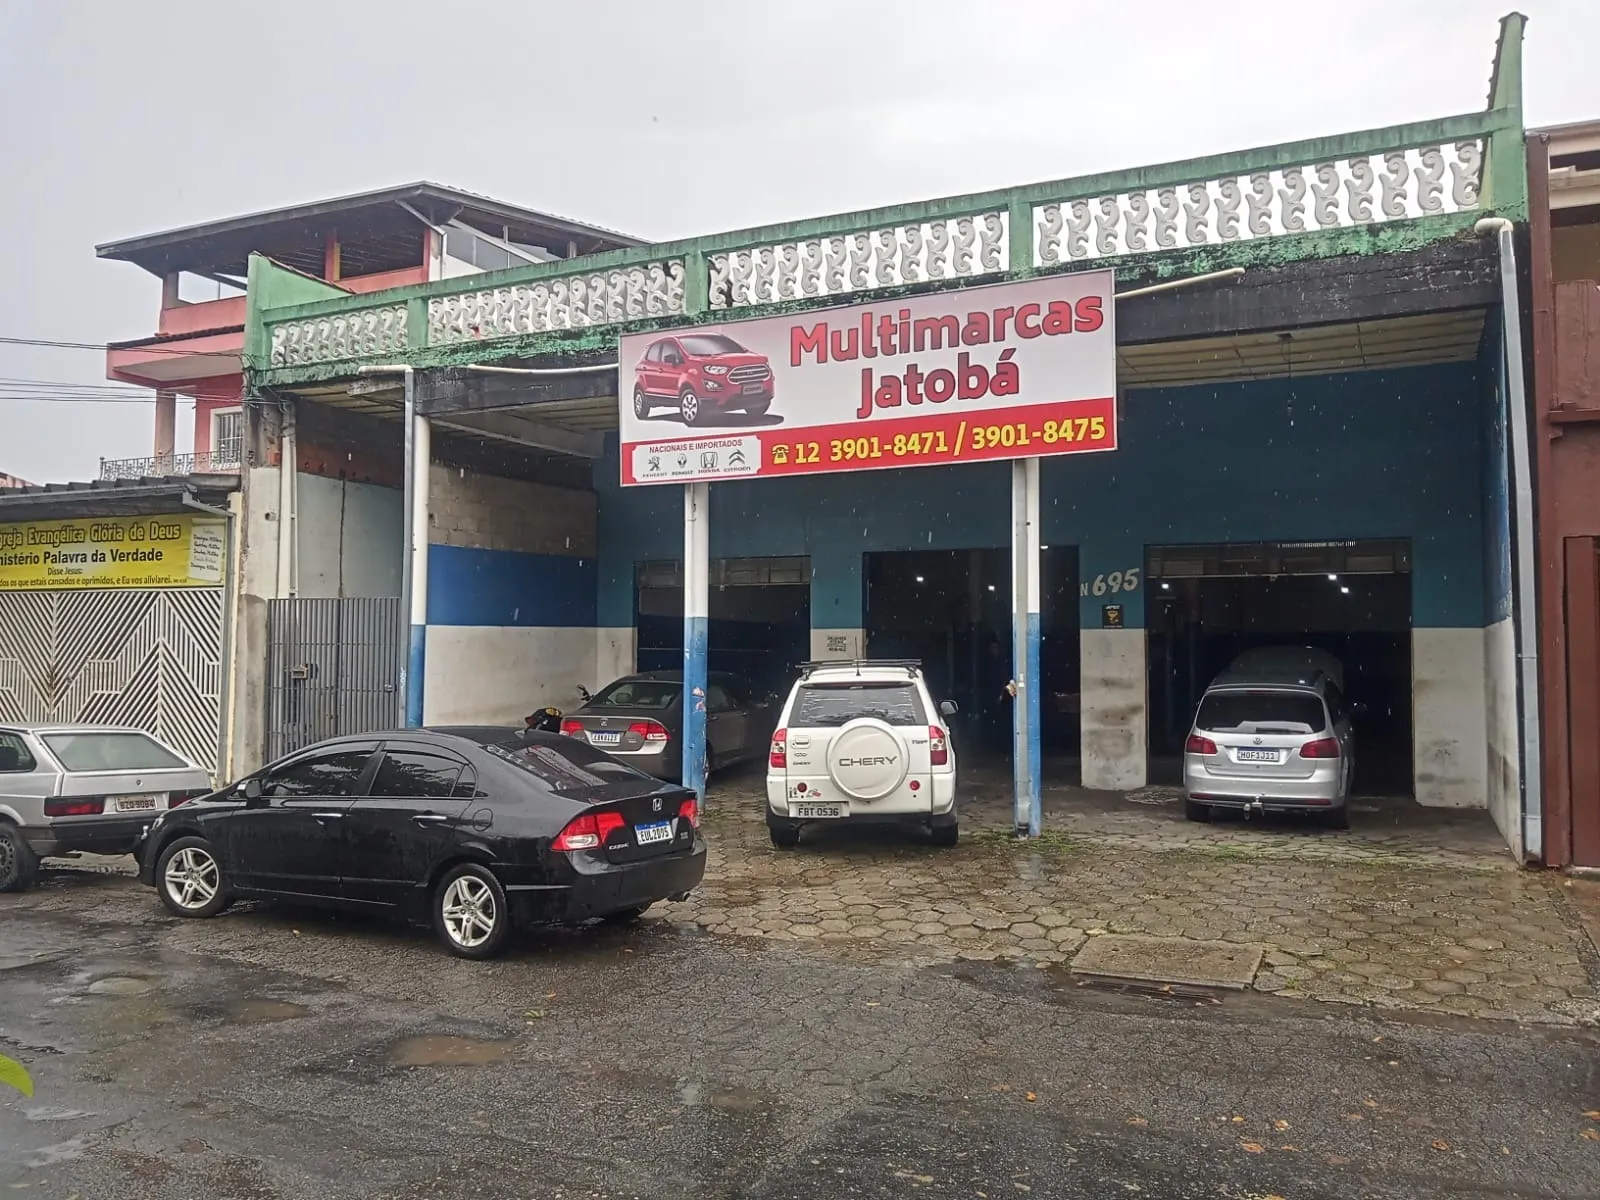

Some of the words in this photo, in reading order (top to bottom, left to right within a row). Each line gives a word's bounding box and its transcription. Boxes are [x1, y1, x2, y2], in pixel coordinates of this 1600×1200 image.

[790, 296, 1104, 366] Multimarcas
[857, 348, 1020, 420] Jatobá
[649, 444, 687, 454] NACIONAIS
[689, 443, 694, 451] E
[695, 439, 743, 450] IMPORTADOS
[795, 442, 820, 464] 12
[830, 430, 948, 462] 3901-8471
[971, 416, 1106, 450] 3901-8475
[27, 524, 85, 548] Evangélica
[90, 523, 124, 542] Glória
[129, 521, 145, 541] de
[150, 521, 181, 541] Deus
[44, 550, 87, 564] Palavra
[91, 549, 106, 563] da
[110, 548, 163, 562] Verdade
[18, 580, 29, 588] que
[30, 578, 47, 586] estais
[48, 577, 75, 586] cansados
[82, 576, 115, 586] oprimidos,
[122, 576, 130, 584] Eu
[48, 567, 63, 576] Disse
[1092, 567, 1140, 597] 695
[839, 756, 897, 767] CHERY
